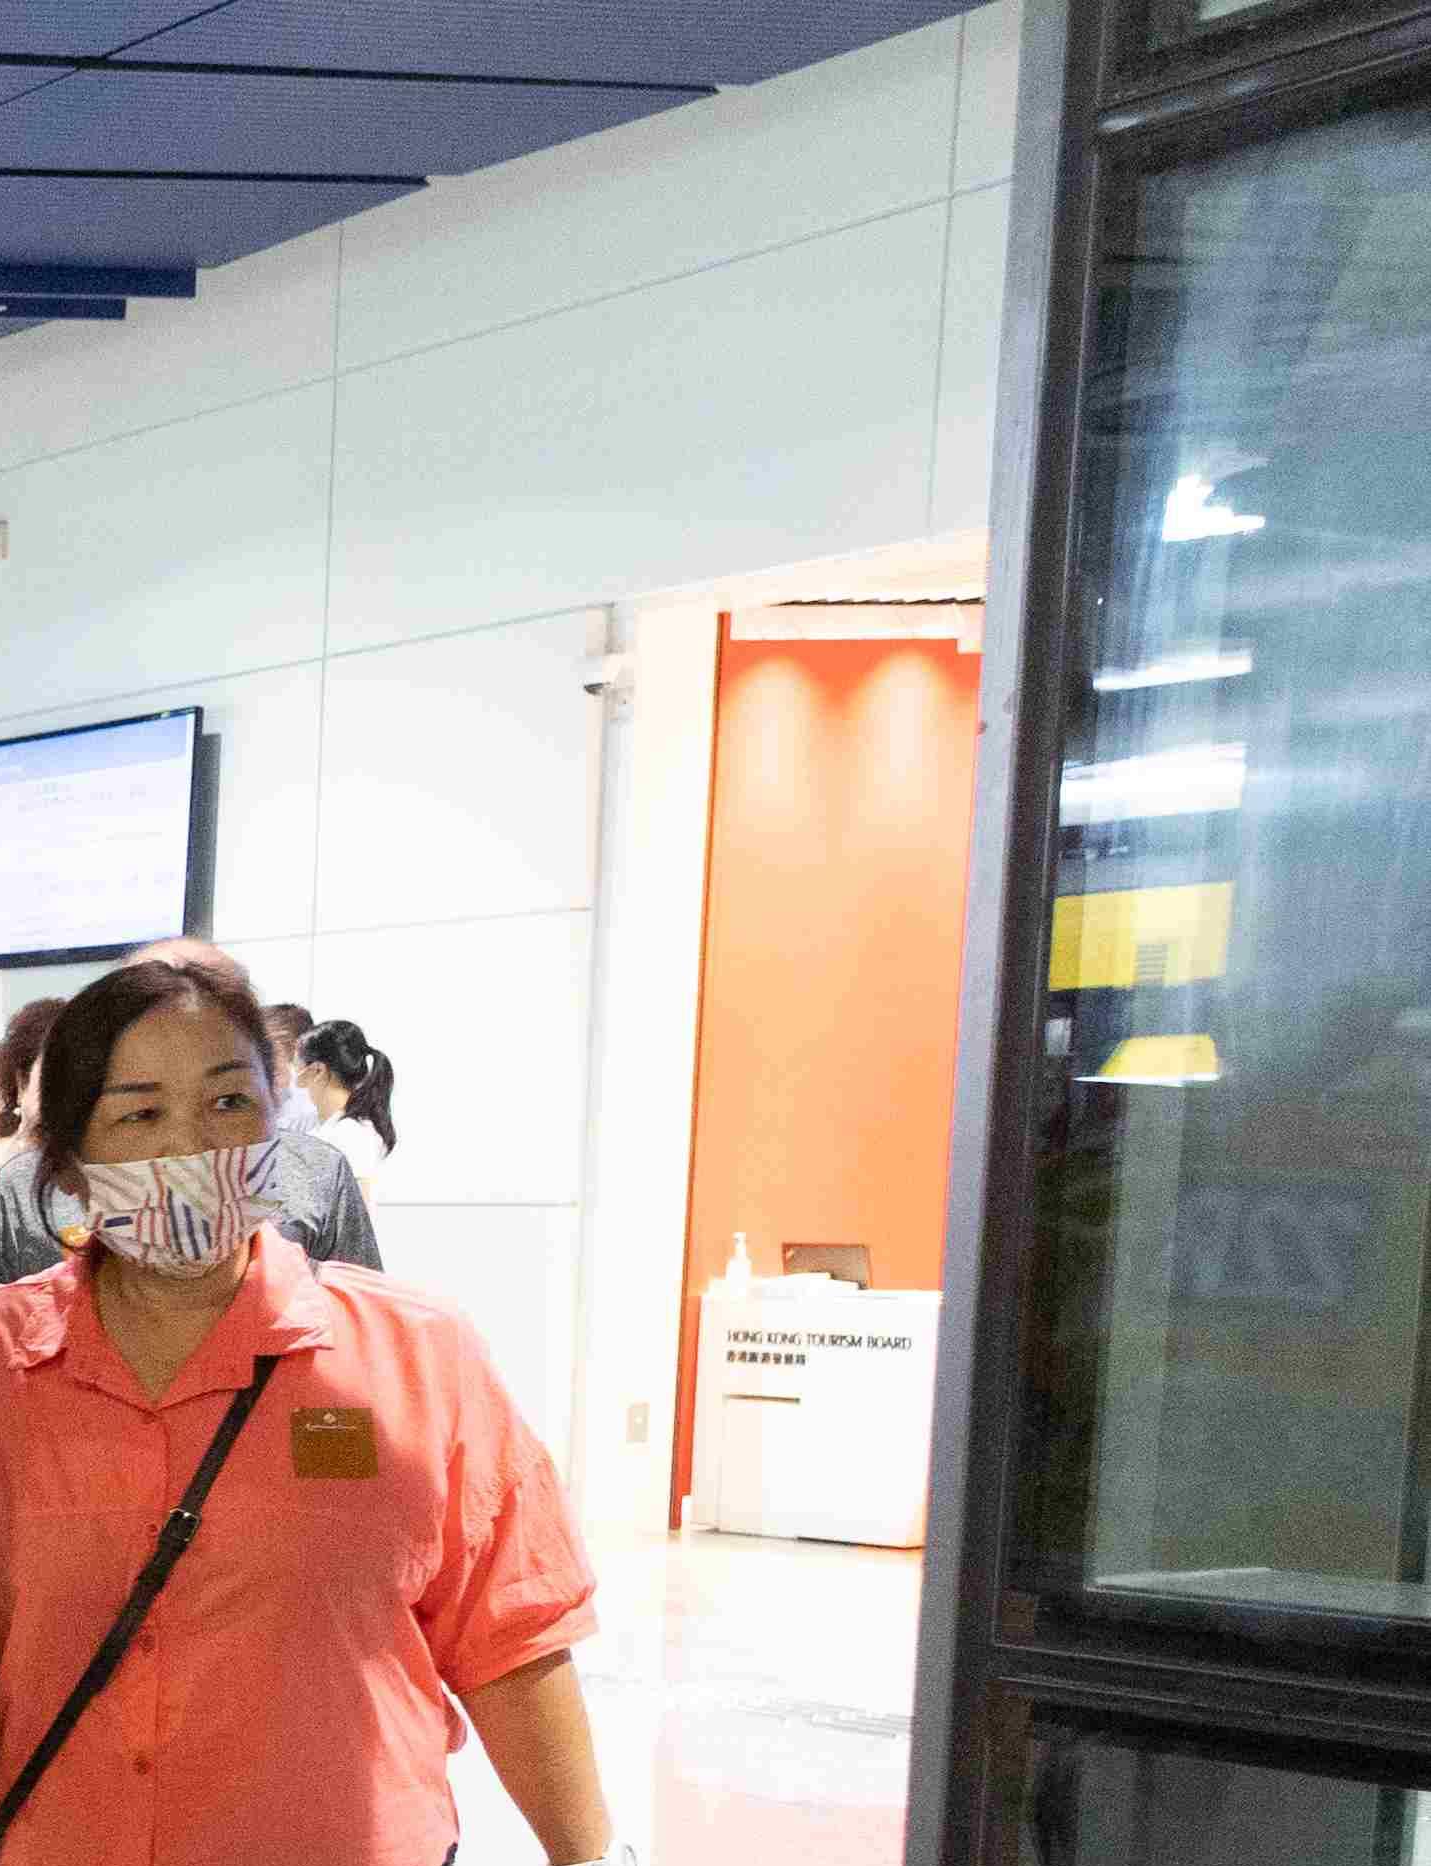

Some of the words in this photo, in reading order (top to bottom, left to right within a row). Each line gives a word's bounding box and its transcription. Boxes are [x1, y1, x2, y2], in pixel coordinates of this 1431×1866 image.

[727, 1330, 763, 1345] HONG
[767, 1332, 801, 1346] KONG
[807, 1333, 863, 1349] TOURISM
[867, 1335, 913, 1351] BOARD
